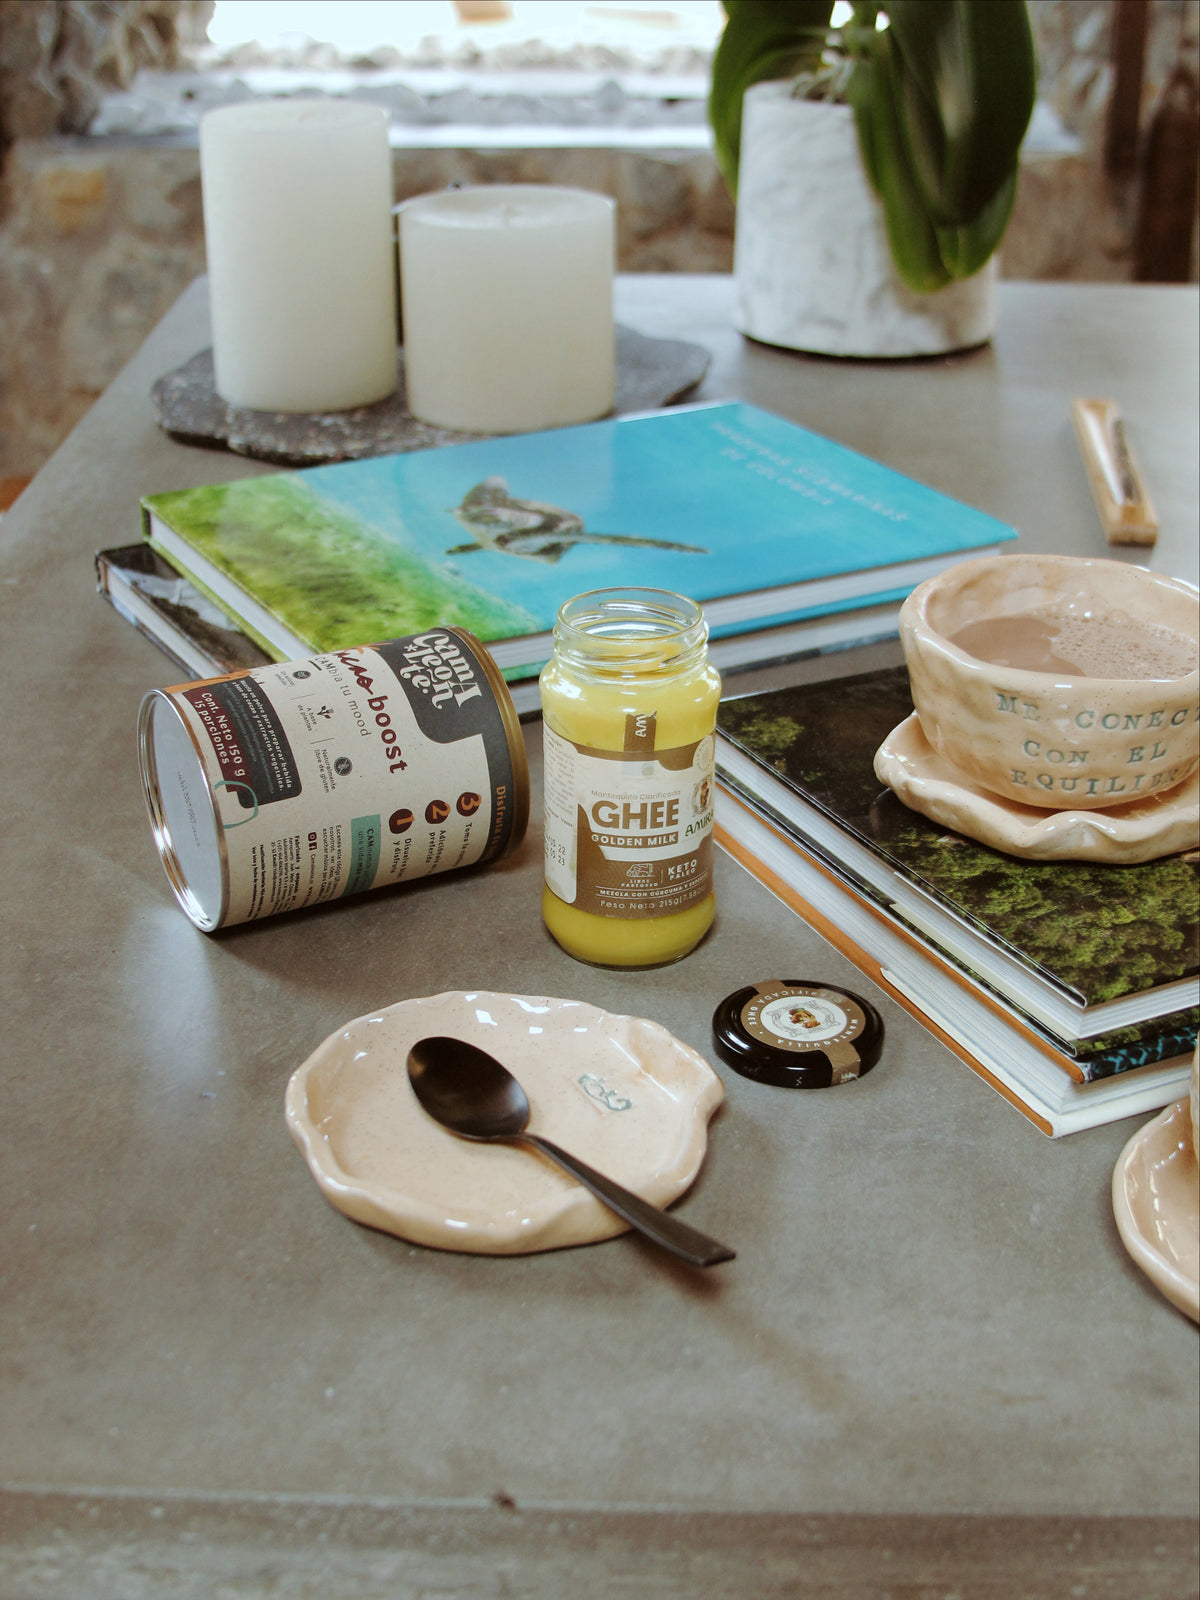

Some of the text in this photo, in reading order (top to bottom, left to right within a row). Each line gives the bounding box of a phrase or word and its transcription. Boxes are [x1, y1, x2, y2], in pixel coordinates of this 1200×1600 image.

[201, 692, 217, 713] Cont.
[339, 684, 350, 696] tu
[348, 699, 371, 737] mood
[996, 693, 1040, 721] ME
[215, 714, 234, 741] Neto
[300, 711, 313, 731] plantas
[308, 711, 318, 725] base
[193, 699, 230, 764] 15 porciones
[368, 696, 407, 773] boost
[227, 743, 243, 764] 150
[244, 698, 257, 714] cacao
[255, 718, 273, 751] extractos
[268, 752, 284, 791] vegetales.
[260, 713, 272, 728] para
[267, 729, 284, 761] preparar
[280, 761, 293, 788] bebida
[1023, 739, 1167, 765] CON EL
[234, 767, 246, 777] g
[318, 763, 324, 772] de
[320, 748, 337, 790] Naturalmente
[319, 772, 330, 793] gluten
[461, 794, 481, 810] 3
[591, 790, 681, 801] Mantequilla Clarificada
[397, 814, 414, 825] 1
[432, 803, 450, 819] 2
[591, 799, 679, 830] GHEE
[463, 822, 472, 842] Toma
[591, 833, 677, 846] GOLDEN MILK
[667, 859, 697, 875] KETO
[669, 868, 696, 881] PALEO
[599, 889, 629, 897] MEZCLA
[650, 886, 683, 897] CÚRCUMA
[600, 899, 625, 910] Peso
[629, 901, 656, 910] Neto
[747, 1006, 759, 1026] GHEE
[777, 1018, 859, 1049] MANTEQUILLA
